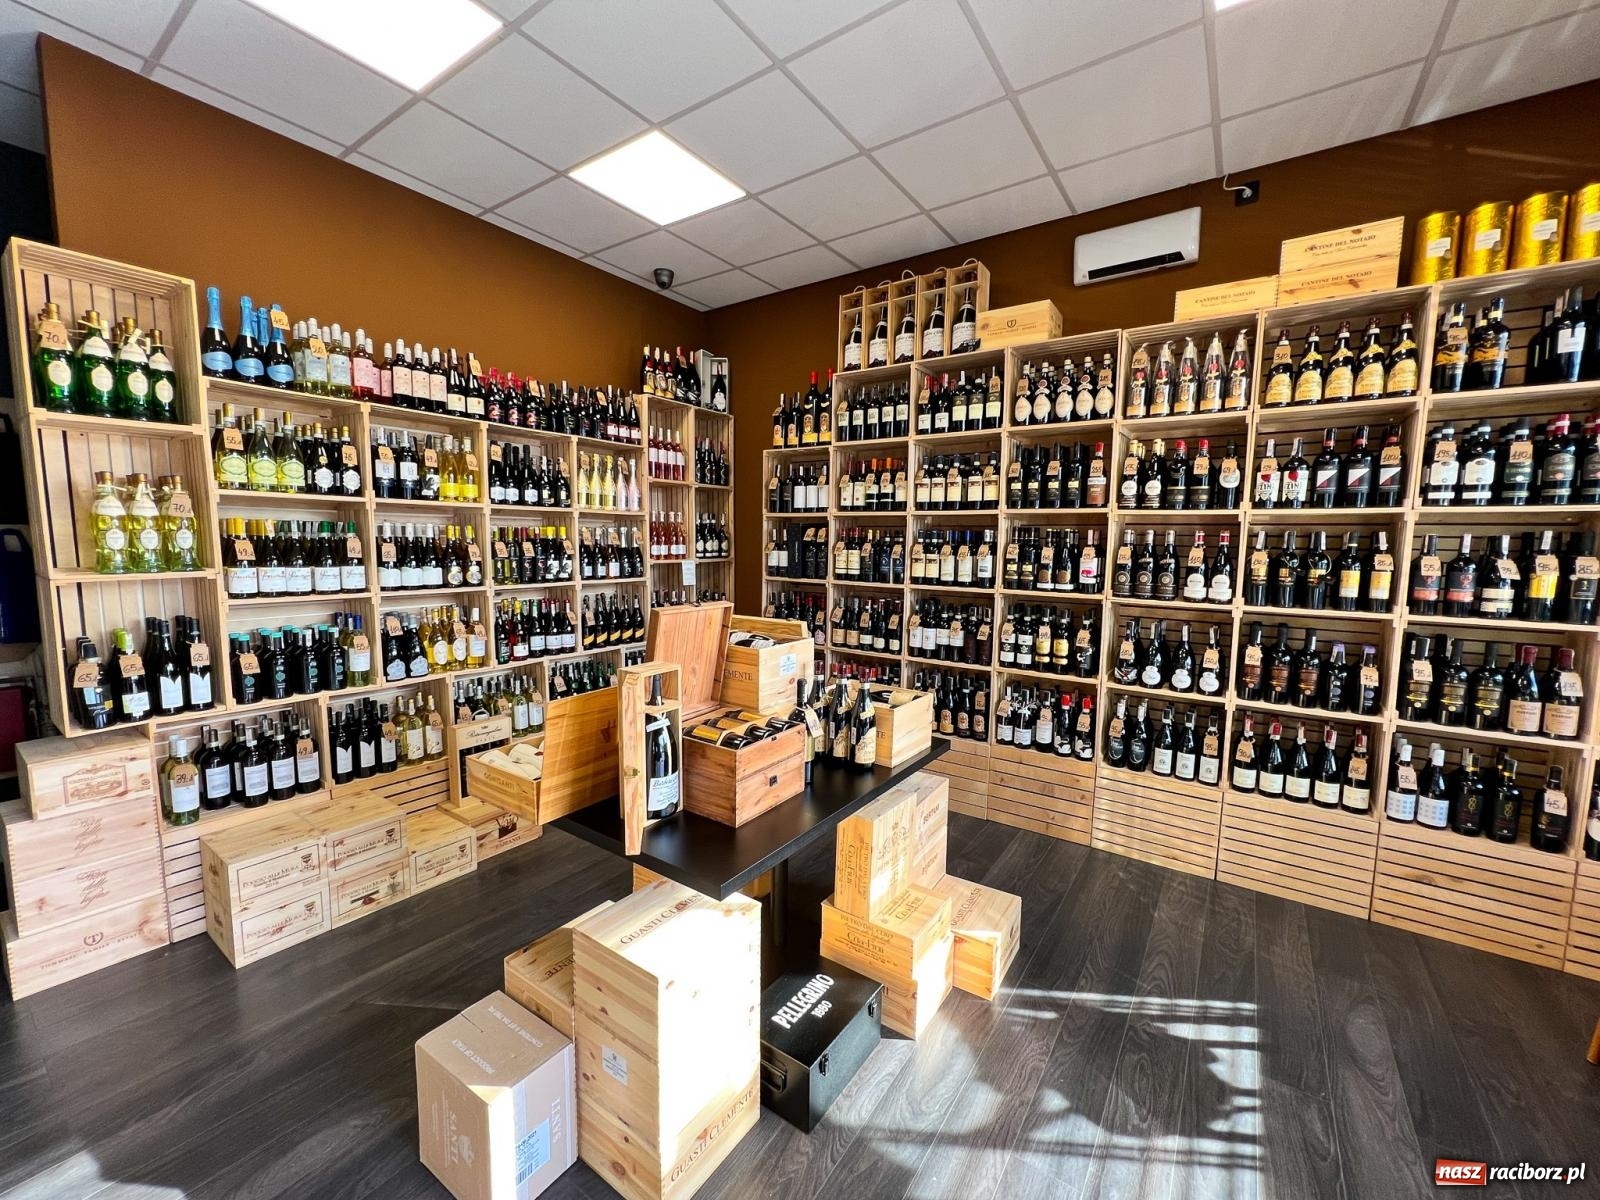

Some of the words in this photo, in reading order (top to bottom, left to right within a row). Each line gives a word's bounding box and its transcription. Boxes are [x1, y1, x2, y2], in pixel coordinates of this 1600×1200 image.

[1334, 239, 1348, 249] DEL
[1300, 277, 1331, 288] CANTINE
[1331, 274, 1345, 283] DEL
[1577, 564, 1593, 575] 85
[1400, 774, 1412, 784] 55
[1545, 799, 1561, 811] 45
[620, 917, 662, 946] GUASTI
[771, 973, 835, 1030] PELLEGRINO
[810, 999, 833, 1019] 1880
[670, 1136, 709, 1184] GUASTI
[707, 1088, 755, 1140] CLEMENTE
